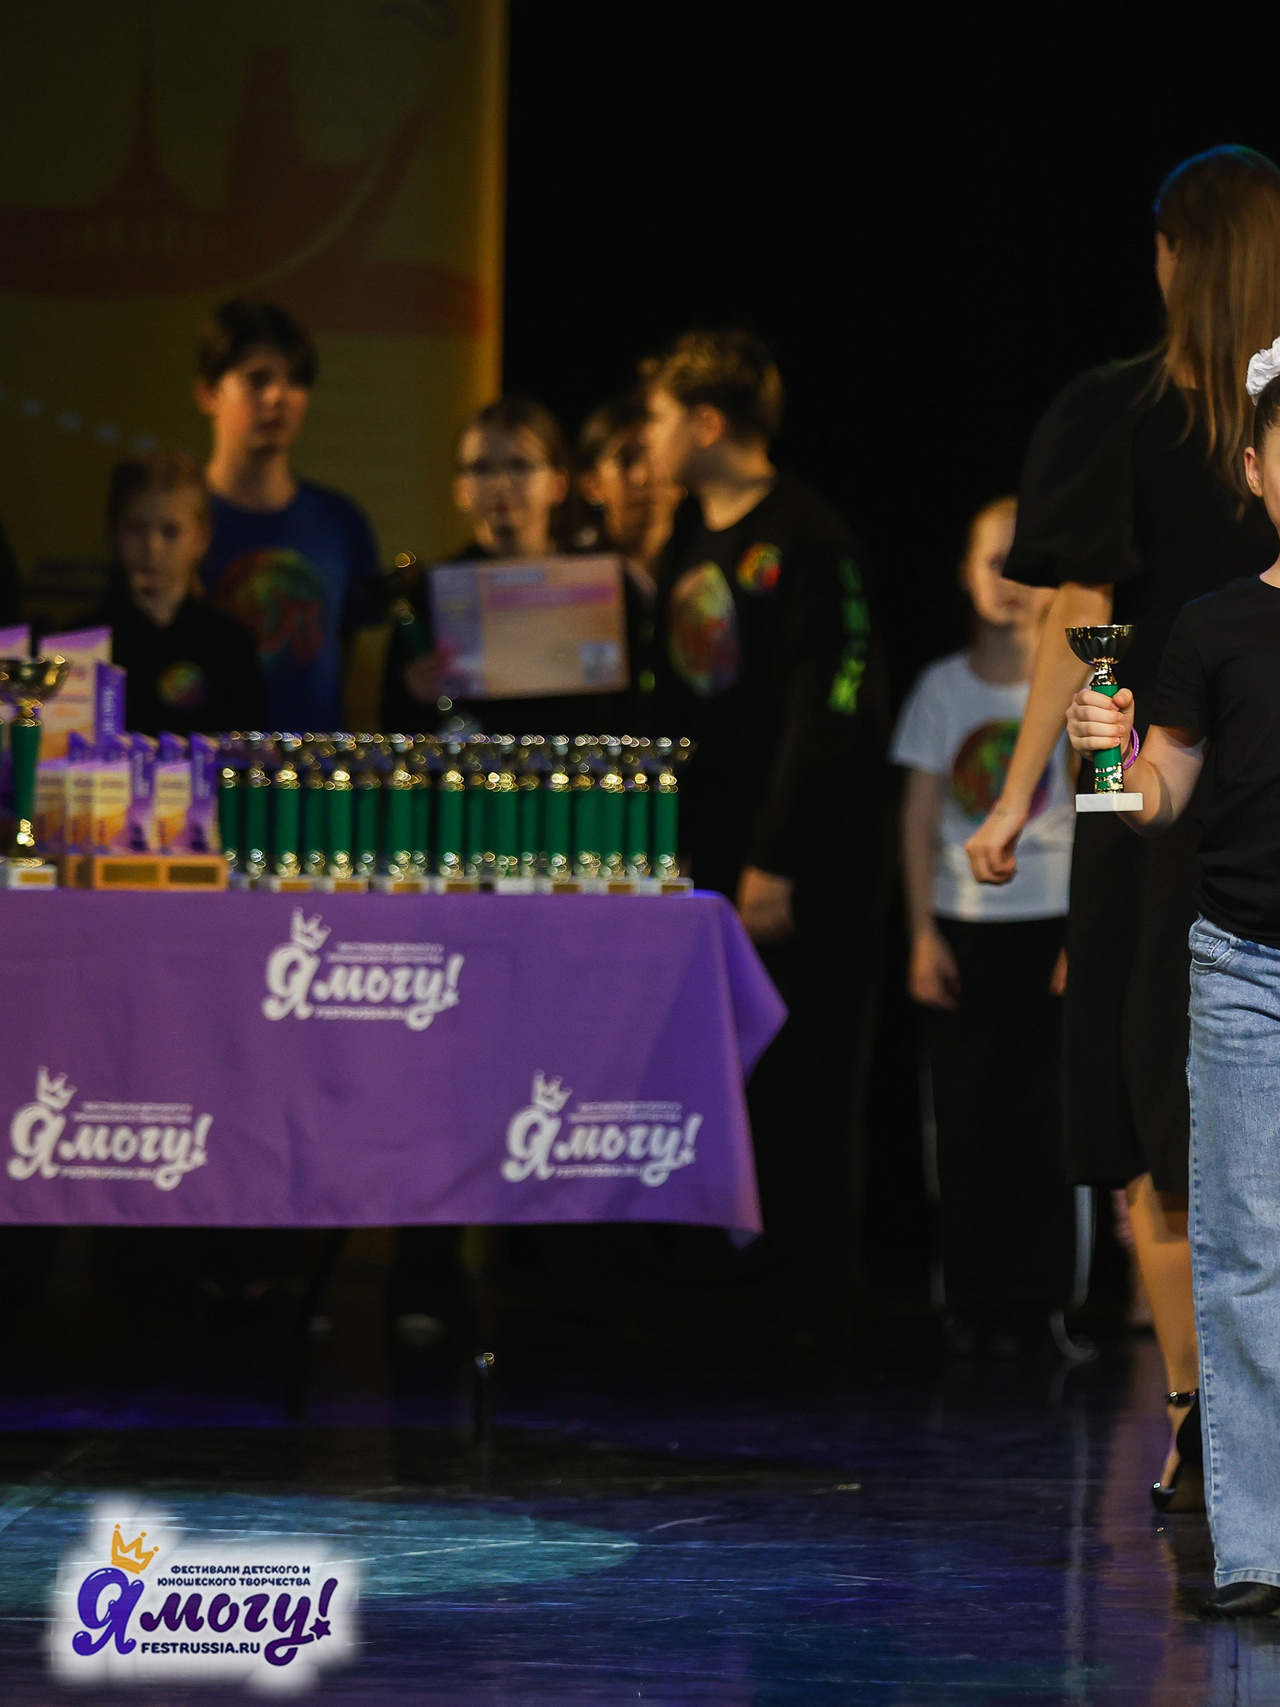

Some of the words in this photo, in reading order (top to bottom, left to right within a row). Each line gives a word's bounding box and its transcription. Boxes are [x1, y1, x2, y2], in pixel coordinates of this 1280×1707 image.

[261, 943, 321, 1021] Я
[311, 953, 465, 1031] могу!
[6, 1102, 67, 1180] Я
[57, 1112, 213, 1191] могу!
[500, 1105, 562, 1182] Я
[553, 1112, 704, 1188] могу!
